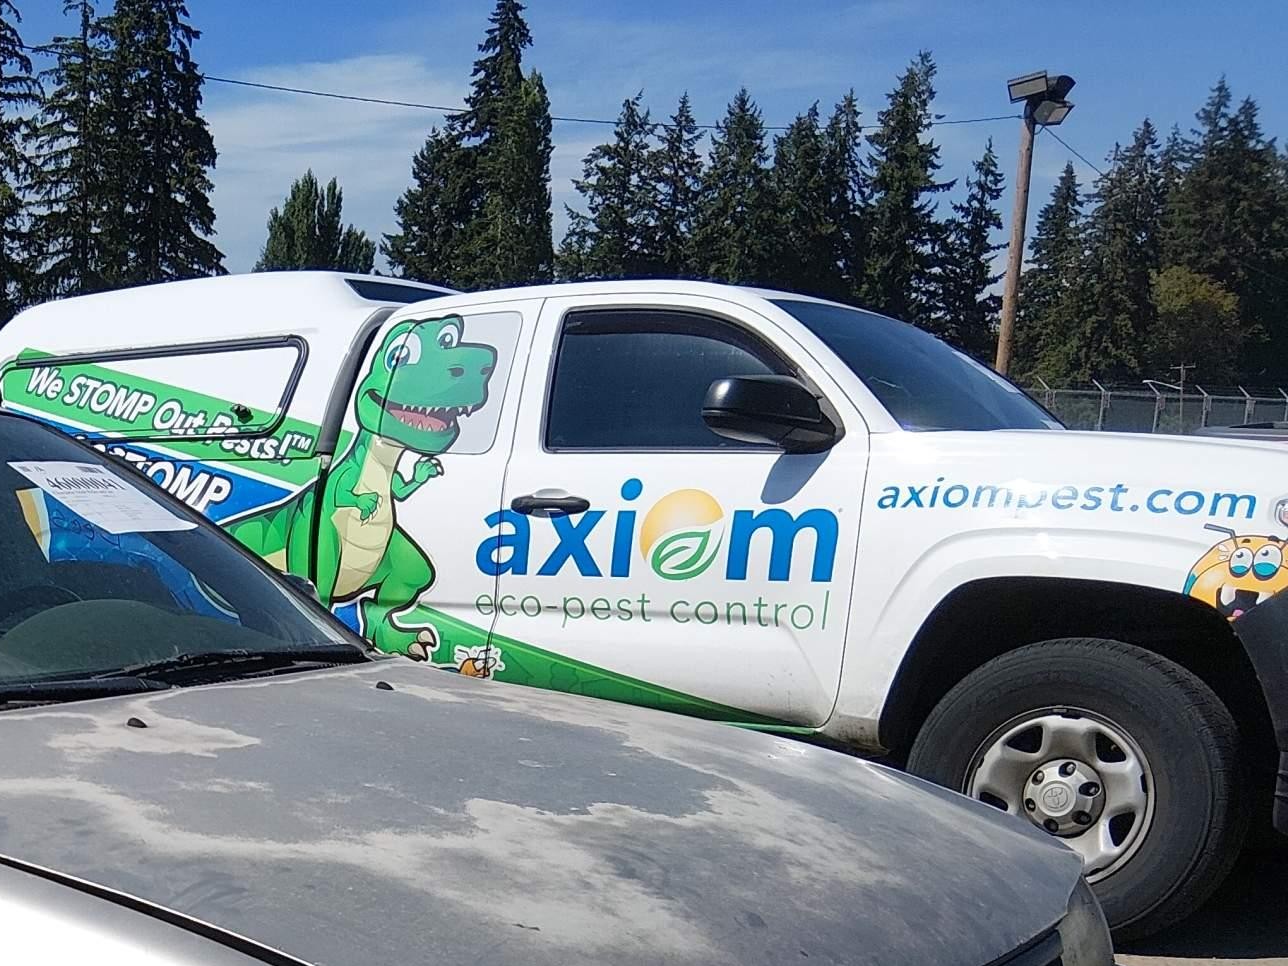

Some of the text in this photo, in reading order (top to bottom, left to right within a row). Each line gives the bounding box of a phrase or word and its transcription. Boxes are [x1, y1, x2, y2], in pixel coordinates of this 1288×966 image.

[27, 366, 63, 398] We
[64, 375, 155, 422] STOMP
[153, 400, 206, 435] Out
[475, 478, 839, 582] axiom
[475, 590, 831, 630] eco-pest control
